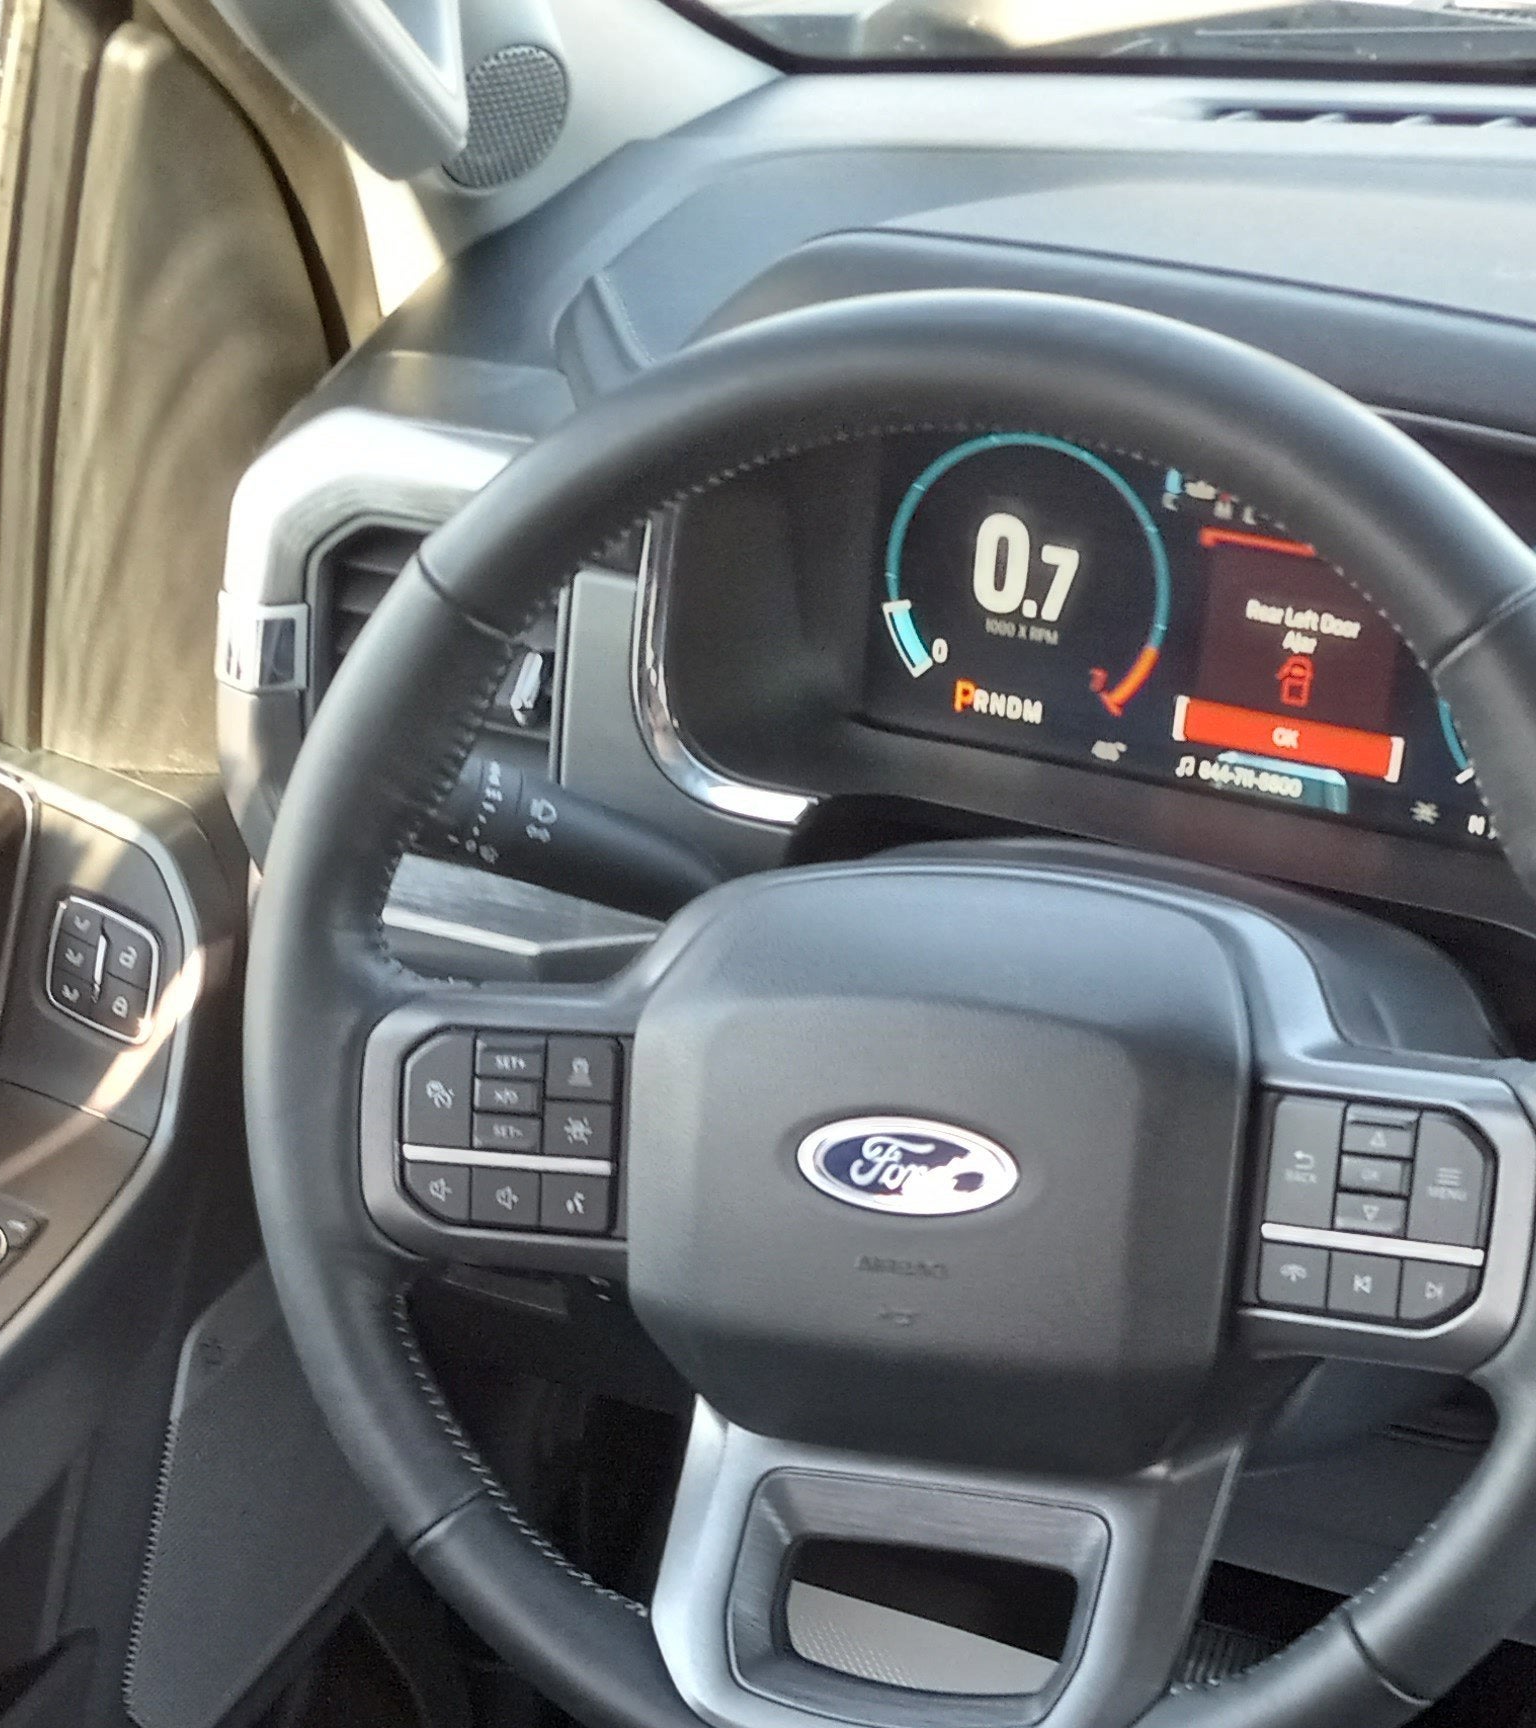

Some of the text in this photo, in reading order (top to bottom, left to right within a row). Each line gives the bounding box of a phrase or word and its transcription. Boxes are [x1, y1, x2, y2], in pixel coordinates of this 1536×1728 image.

[973, 512, 1080, 622] 0.7
[1245, 599, 1361, 639] Rear Left Door
[1029, 626, 1059, 646] RPM
[1282, 631, 1317, 655] Ajar
[932, 638, 948, 663] 0
[1273, 727, 1299, 749] OK
